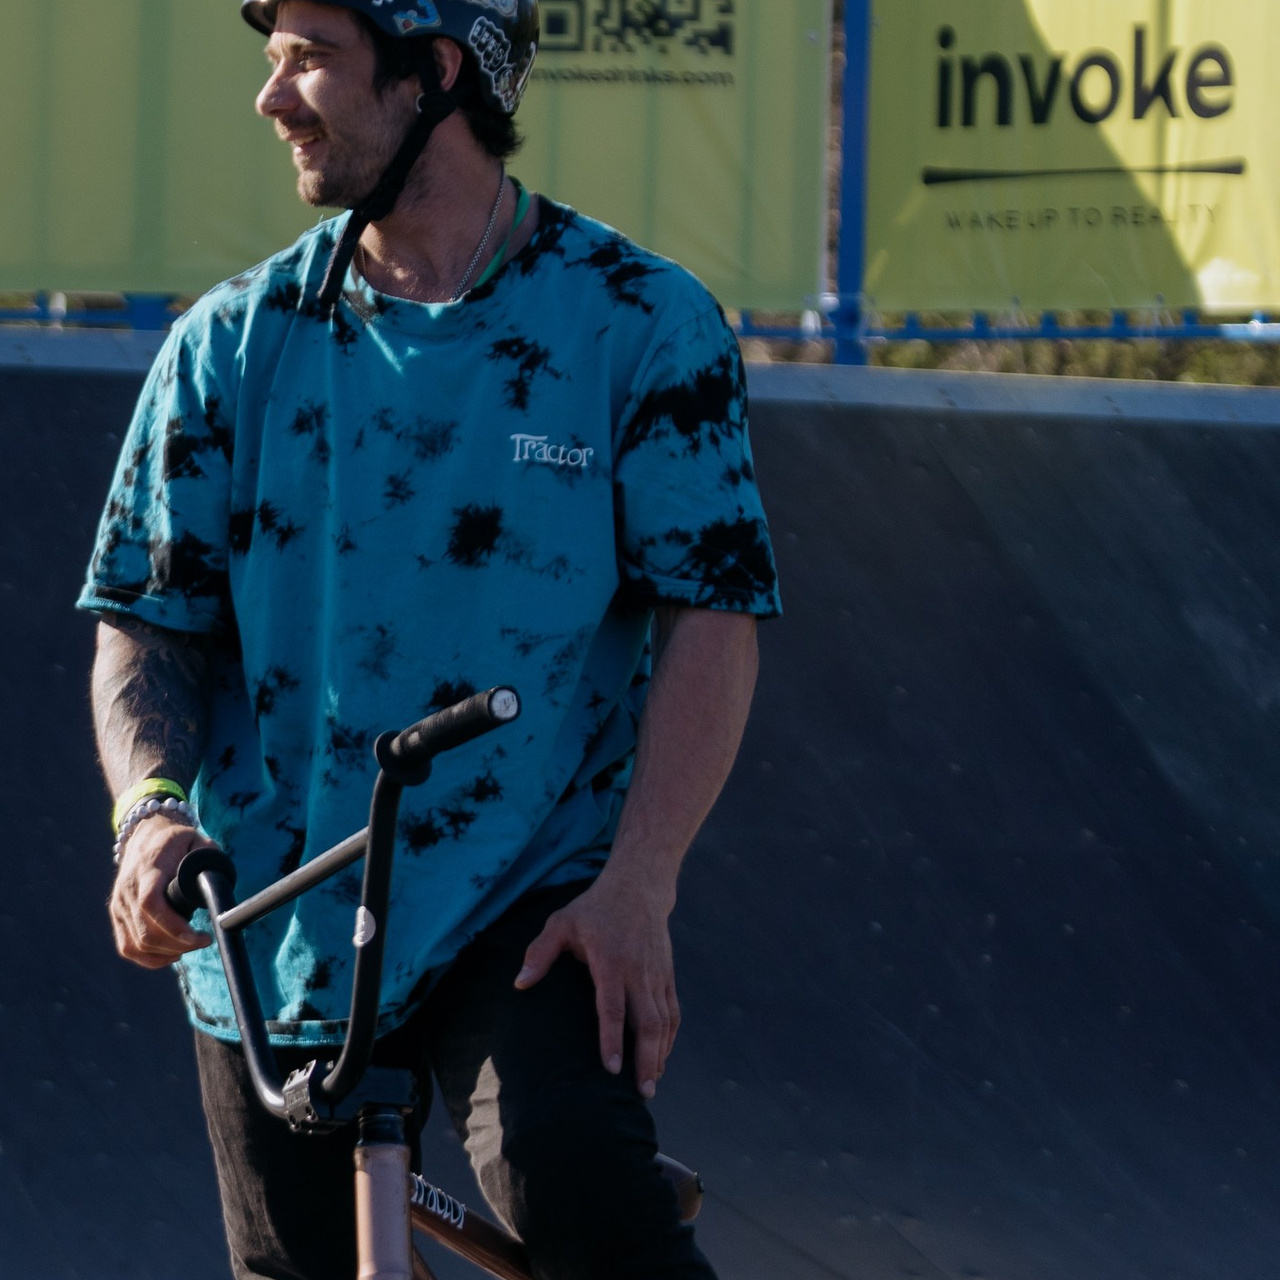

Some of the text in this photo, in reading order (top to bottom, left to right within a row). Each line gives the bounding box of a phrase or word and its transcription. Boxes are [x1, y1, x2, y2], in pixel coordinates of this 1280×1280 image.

[936, 22, 1234, 128] invoke
[945, 202, 1217, 232] WAKE UP TO REATY
[509, 433, 594, 467] Tractor
